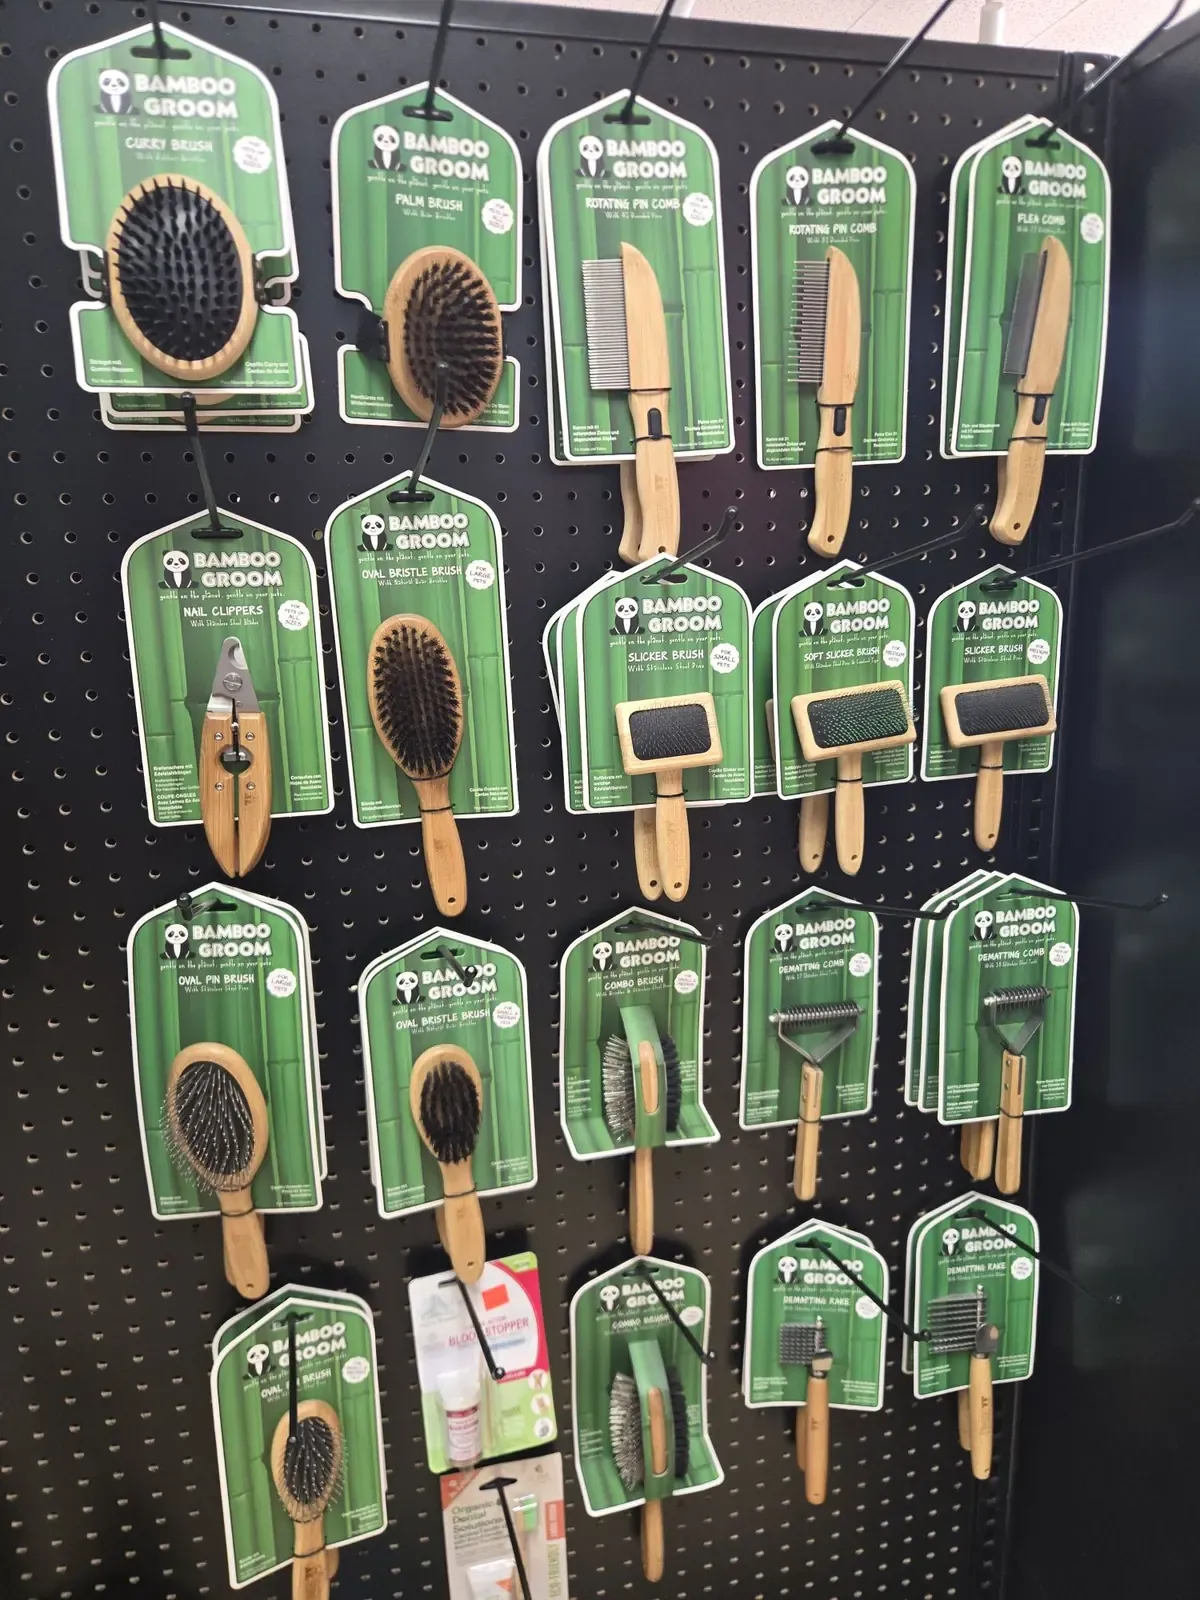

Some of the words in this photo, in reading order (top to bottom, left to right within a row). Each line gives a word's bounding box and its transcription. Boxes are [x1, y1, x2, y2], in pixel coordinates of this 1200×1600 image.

[133, 73, 236, 96] BAMBOO
[143, 97, 239, 119] GROOM
[125, 137, 166, 150] CURRY
[171, 138, 213, 152] BRUSH
[404, 131, 490, 159] BAMBOO
[606, 139, 686, 158] BAMBOO
[410, 155, 490, 181] GROOM
[613, 160, 688, 179] GROOM
[812, 166, 887, 185] BAMBOO
[1024, 160, 1087, 180] BAMBOO
[817, 187, 886, 205] GROOM
[1028, 180, 1087, 199] GROOM
[396, 193, 424, 208] PALM
[428, 197, 463, 211] BRUSH
[585, 197, 630, 210] ROTATING
[633, 198, 649, 209] PIN
[651, 197, 681, 210] COMB
[1017, 213, 1039, 224] FLEA
[789, 224, 829, 236] ROTATING
[833, 223, 848, 234] PIN
[850, 222, 877, 234] COMB
[389, 513, 469, 531] BAMBOO
[396, 532, 470, 549] GROOM
[193, 551, 281, 568] BAMBOO
[201, 570, 283, 587] GROOM
[362, 569, 385, 579] OVAL
[389, 567, 428, 578] BRISTLE
[432, 565, 462, 576] BRUSH
[184, 606, 207, 617] NAIL
[212, 605, 264, 617] CLIPPERS
[642, 596, 722, 614] BAMBOO
[826, 598, 890, 617] BAMBOO
[979, 599, 1039, 615] BAMBOO
[648, 615, 722, 633] GROOM
[830, 615, 889, 633] GROOM
[982, 615, 1038, 630] GROOM
[628, 651, 668, 662] SLICKER
[672, 649, 704, 660] BRUSH
[804, 652, 824, 662] SOFT
[826, 648, 854, 660] SLICKER
[857, 647, 880, 656] BRUSH
[964, 646, 995, 655] SLICKER
[998, 644, 1024, 653] BRUSH
[996, 905, 1056, 923] BAMBOO
[192, 923, 272, 940] BAMBOO
[796, 917, 855, 936] BAMBOO
[1000, 920, 1055, 938] GROOM
[198, 941, 272, 958] GROOM
[616, 936, 680, 954] BAMBOO
[799, 932, 855, 950] GROOM
[620, 949, 680, 968] GROOM
[978, 951, 1020, 962] DEMATTING
[1023, 947, 1045, 957] COMB
[779, 961, 820, 974] DEMATTING
[823, 959, 845, 968] COMB
[178, 975, 202, 986] OVAL
[205, 974, 220, 984] PIN
[223, 974, 255, 984] BRUSH
[428, 979, 497, 999] GROOM
[604, 980, 634, 991] COMBO
[638, 975, 664, 986] BRUSH
[396, 1020, 418, 1030] OVAL
[421, 1013, 458, 1026] BRISTLE
[462, 1008, 491, 1019] BRUSH
[485, 1317, 529, 1337] STOPPER
[302, 1368, 332, 1385] BRUSH
